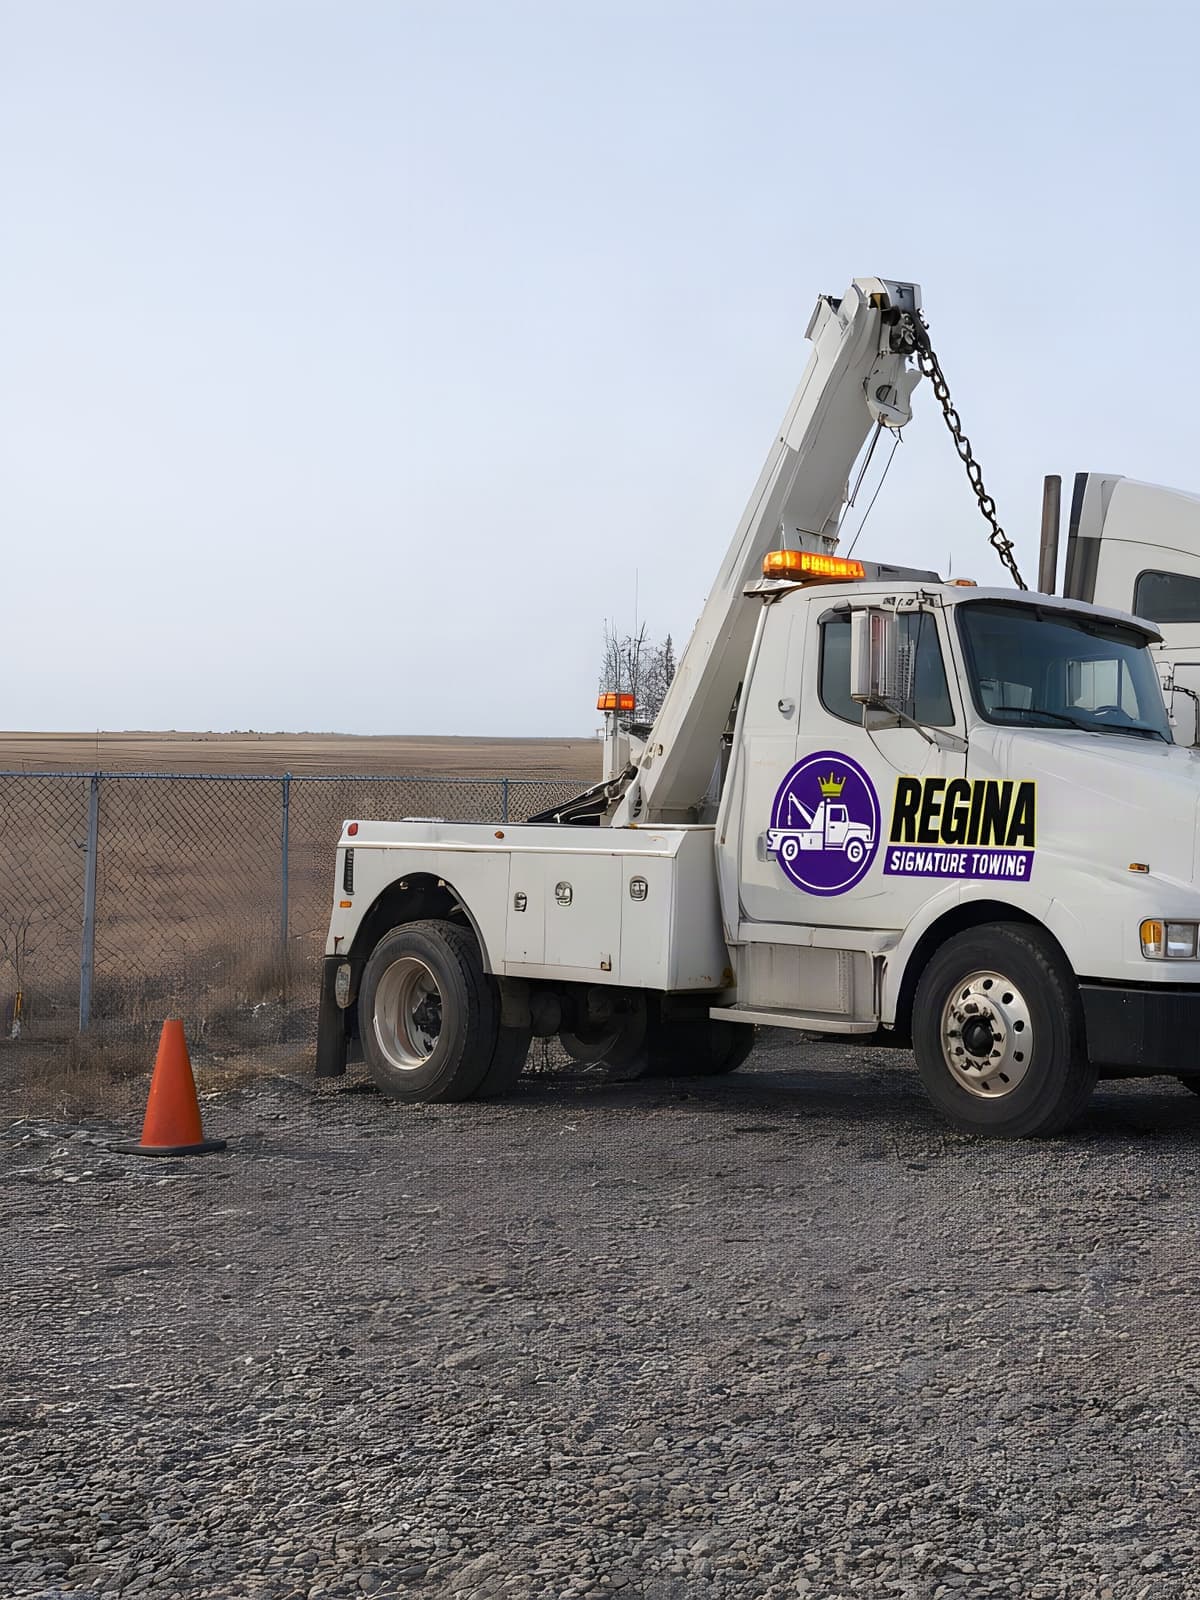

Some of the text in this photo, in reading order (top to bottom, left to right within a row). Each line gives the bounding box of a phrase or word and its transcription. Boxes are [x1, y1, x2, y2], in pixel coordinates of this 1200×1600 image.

[889, 776, 1036, 847] REGINA
[890, 851, 1026, 876] SIGNATURE TOWING
